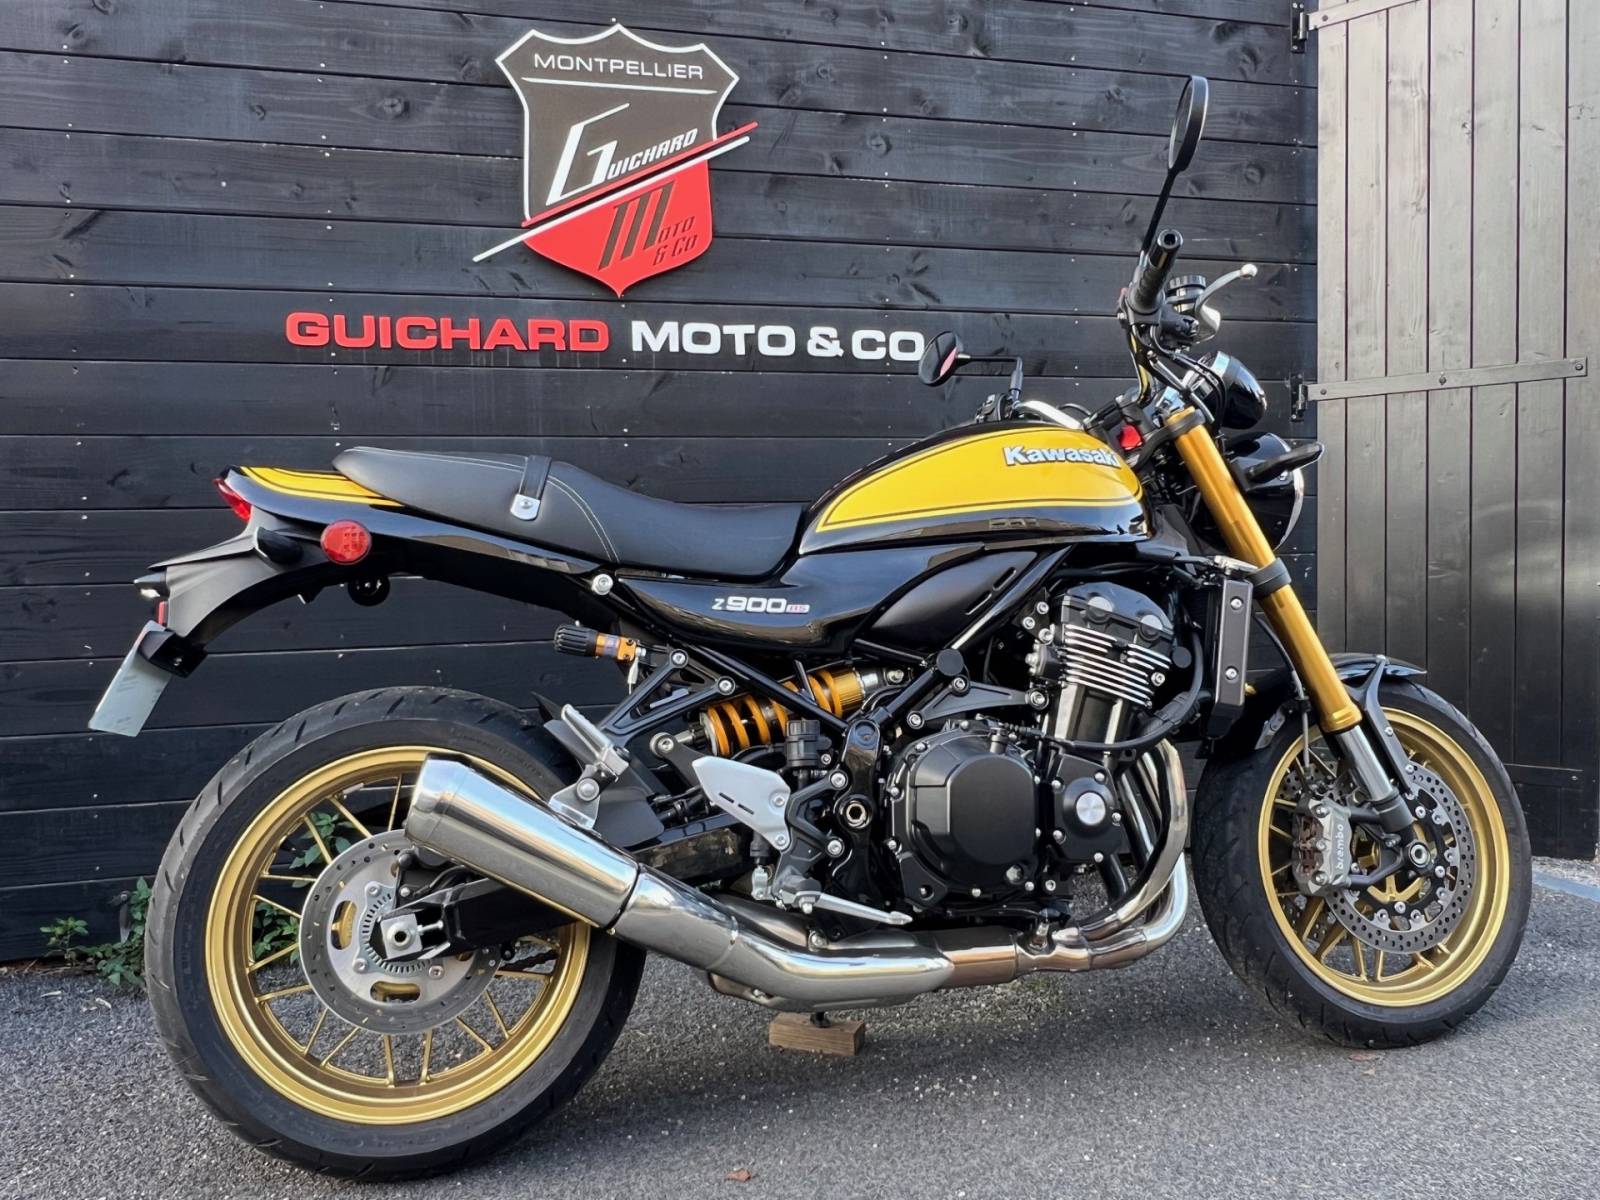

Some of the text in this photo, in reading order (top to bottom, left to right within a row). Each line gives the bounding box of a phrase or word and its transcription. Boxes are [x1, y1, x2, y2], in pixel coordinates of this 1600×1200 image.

[533, 52, 704, 80] MONTPELLIER
[545, 102, 698, 206] GUICHARD
[285, 311, 610, 352] GUICHARD
[631, 320, 796, 357] MOTO
[1003, 445, 1122, 469] Kawasaki
